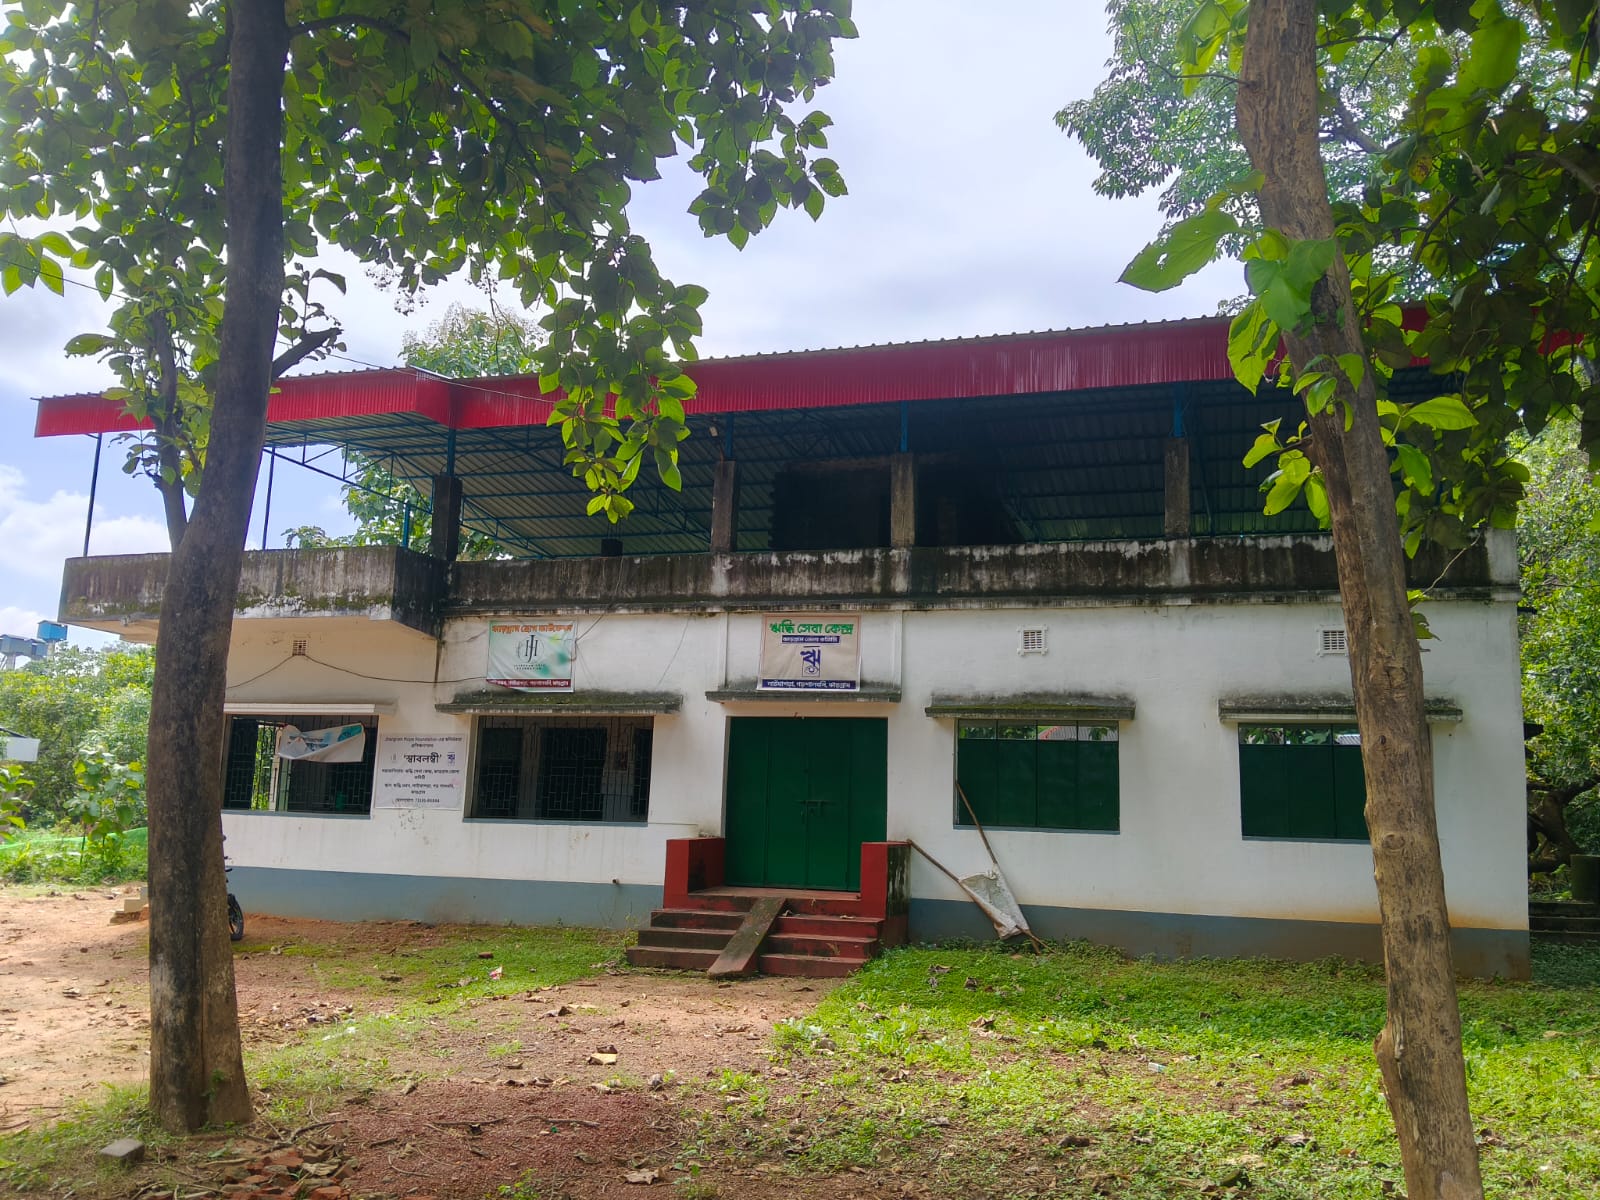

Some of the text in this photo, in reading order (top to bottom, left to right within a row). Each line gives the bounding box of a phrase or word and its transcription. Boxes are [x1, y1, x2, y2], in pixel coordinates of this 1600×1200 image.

[770, 619, 854, 635] ঋদ্ধি সেবা কেন্দ্র
